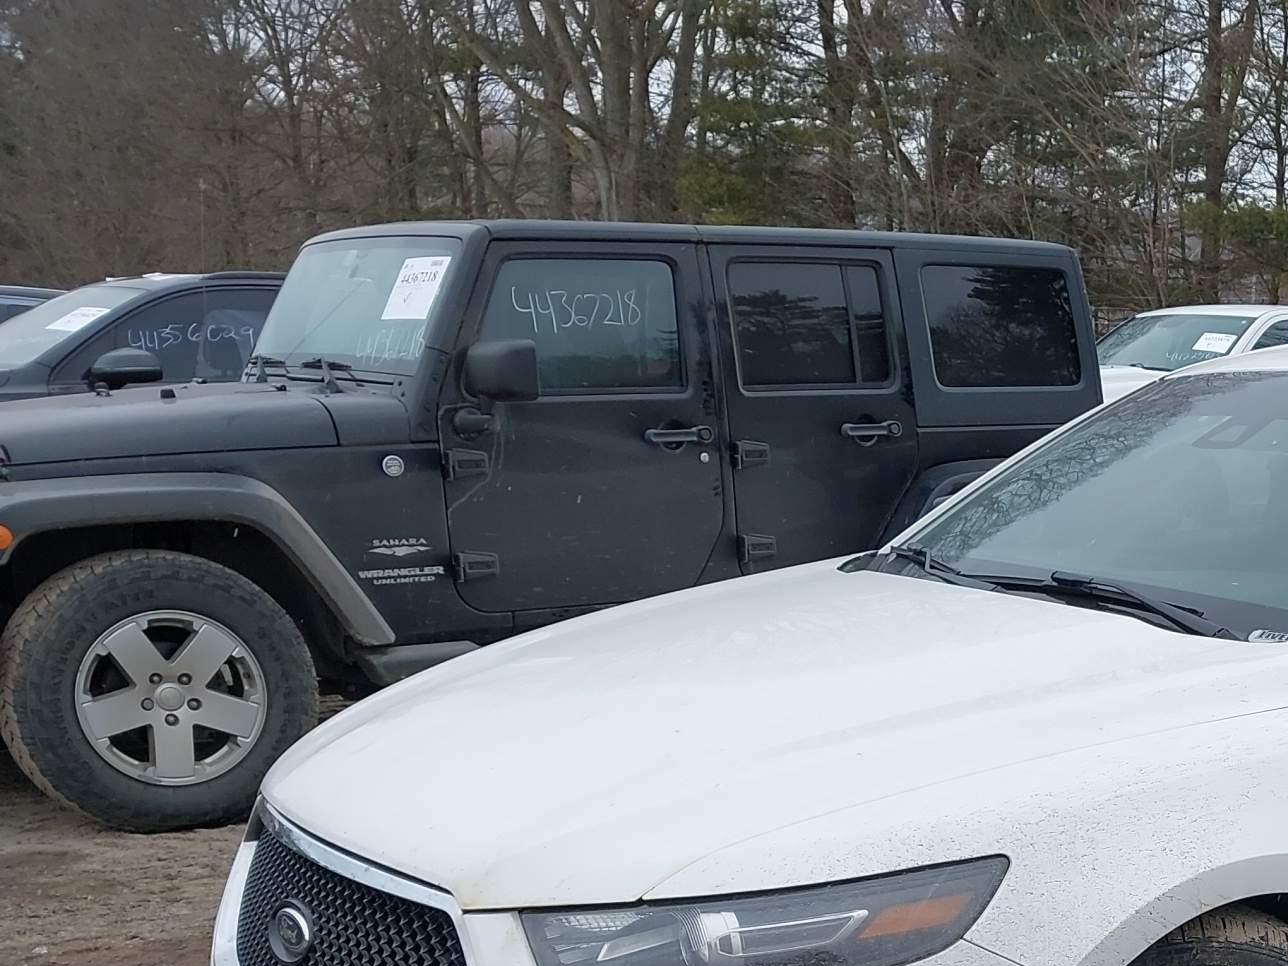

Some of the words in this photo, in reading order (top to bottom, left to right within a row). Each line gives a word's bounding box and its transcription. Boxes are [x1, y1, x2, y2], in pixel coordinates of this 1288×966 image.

[511, 286, 641, 333] 44367218
[127, 322, 255, 351] 44356029
[372, 537, 428, 547] SAHARA
[358, 566, 445, 578] WRANGLER
[373, 575, 436, 585] UNLIMITED
